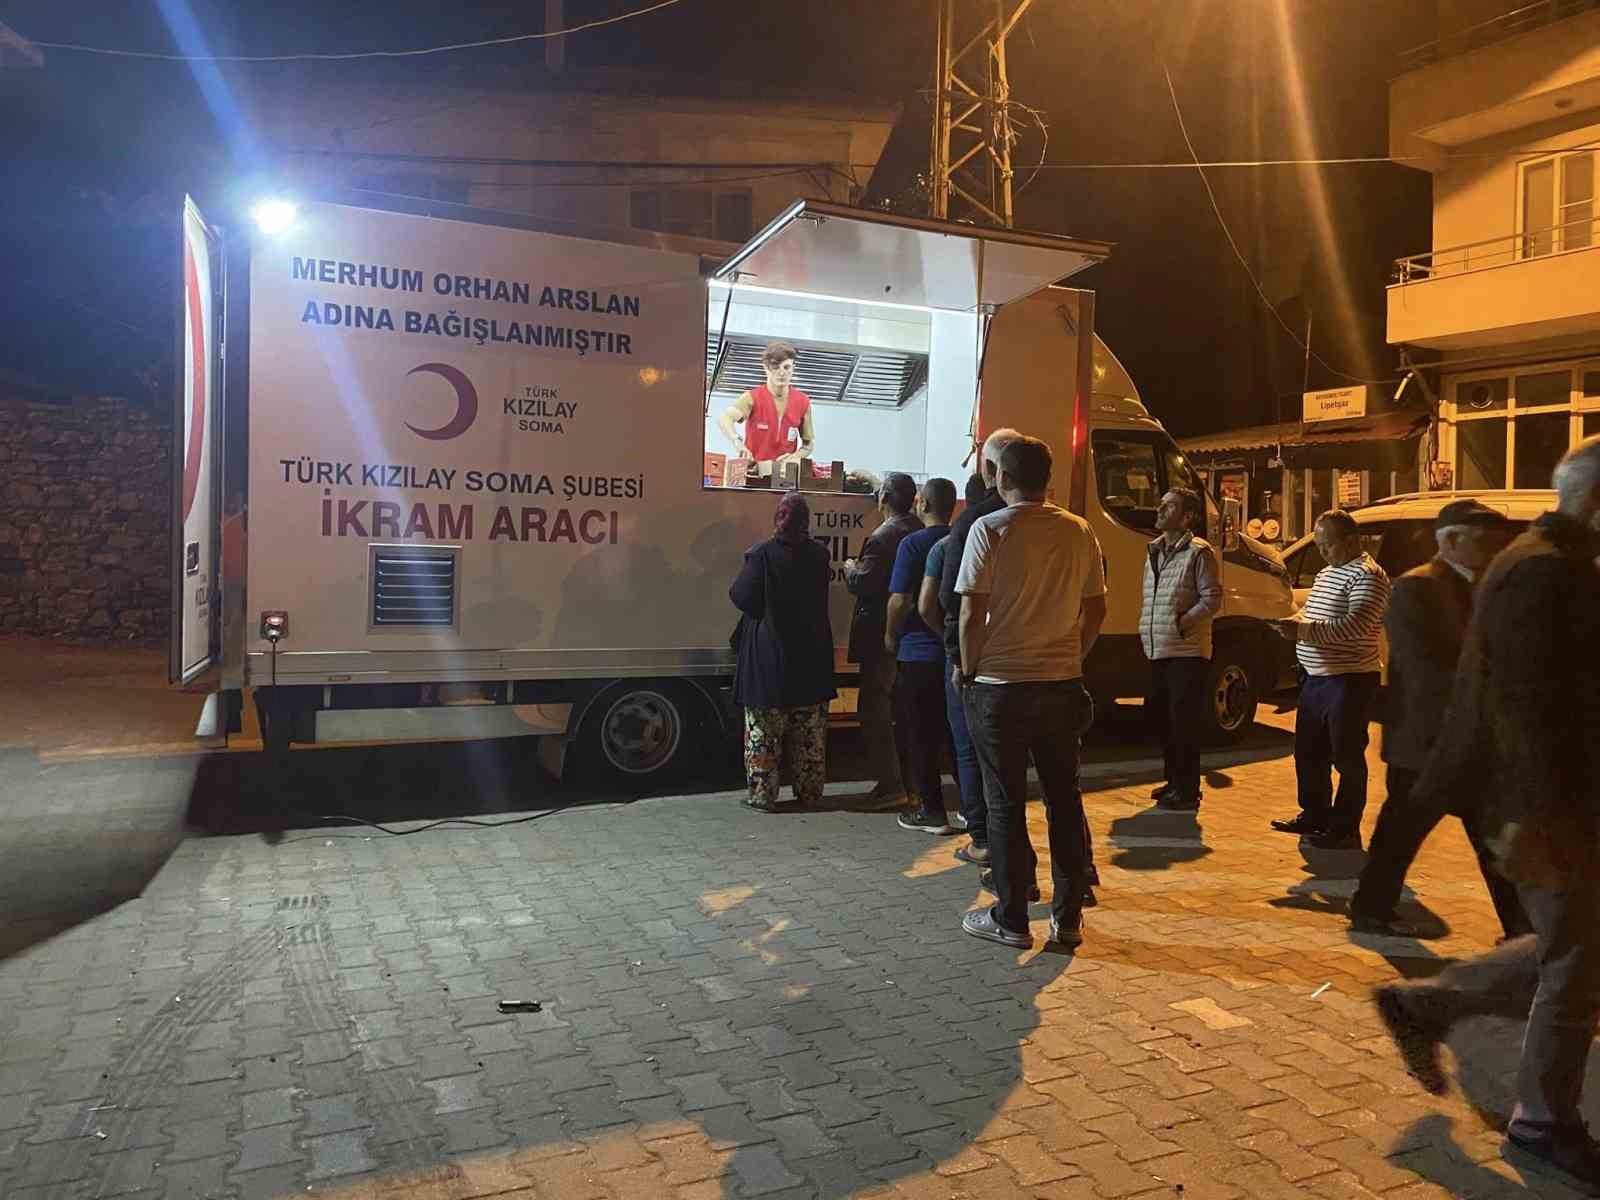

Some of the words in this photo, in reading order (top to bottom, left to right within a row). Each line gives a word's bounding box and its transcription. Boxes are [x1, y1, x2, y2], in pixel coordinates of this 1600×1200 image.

[292, 256, 424, 293] MERHUM
[433, 272, 529, 305] ORHAN
[539, 286, 640, 317] ARSLAN
[302, 301, 395, 331] ADINA
[404, 310, 633, 356] BAĞIŞLANMIŞTIR
[503, 398, 578, 419] KIZILAY
[526, 385, 558, 399] TÜRK
[519, 419, 565, 434] SOMA
[279, 456, 353, 486] TÜRK
[362, 463, 457, 490] KIZILAY
[465, 470, 555, 495] SOMA
[563, 474, 645, 501] ŞUBESİ
[321, 487, 475, 541] İKRAM
[488, 506, 618, 545] ARACI
[813, 510, 865, 529] TÜRK
